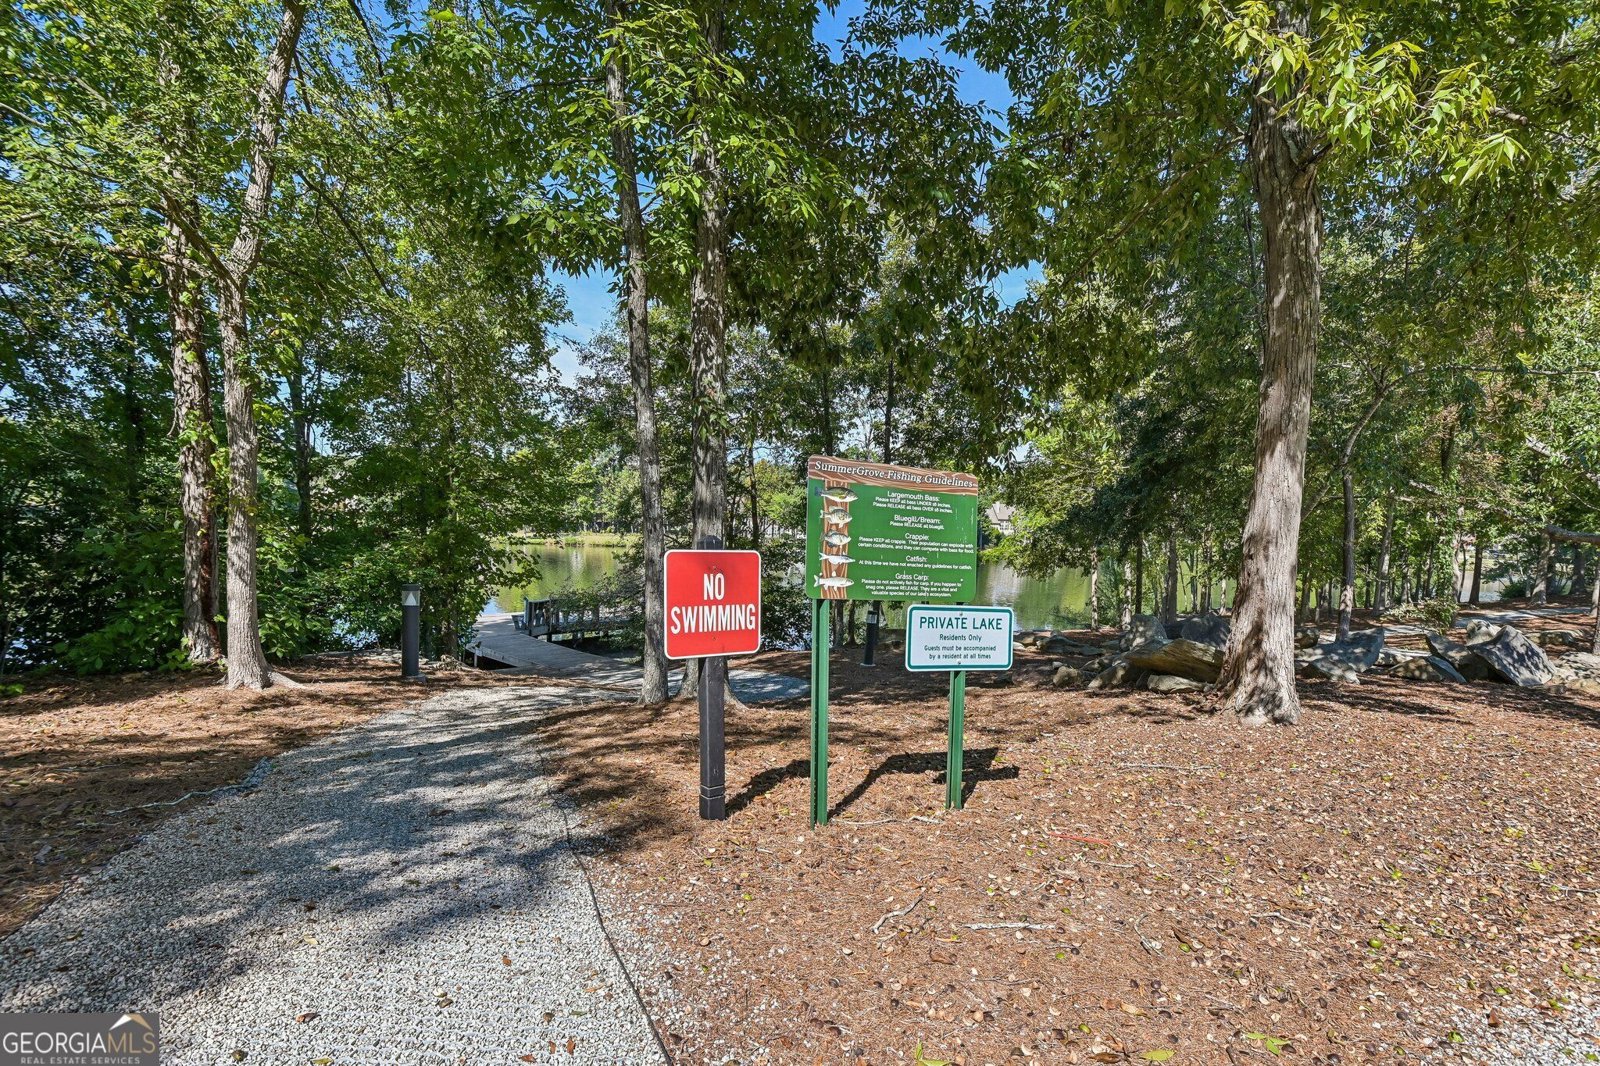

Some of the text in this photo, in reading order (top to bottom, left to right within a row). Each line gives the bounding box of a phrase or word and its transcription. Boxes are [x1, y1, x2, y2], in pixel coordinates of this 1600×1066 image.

[815, 462, 973, 487] SummerGrove Fishing Guidelines
[888, 491, 923, 499] Largemouth
[894, 514, 940, 524] Bluegill/Bream:
[704, 573, 725, 600] NO
[671, 604, 756, 634] SWIMMING
[920, 617, 1002, 630] PRIVATE LAKE
